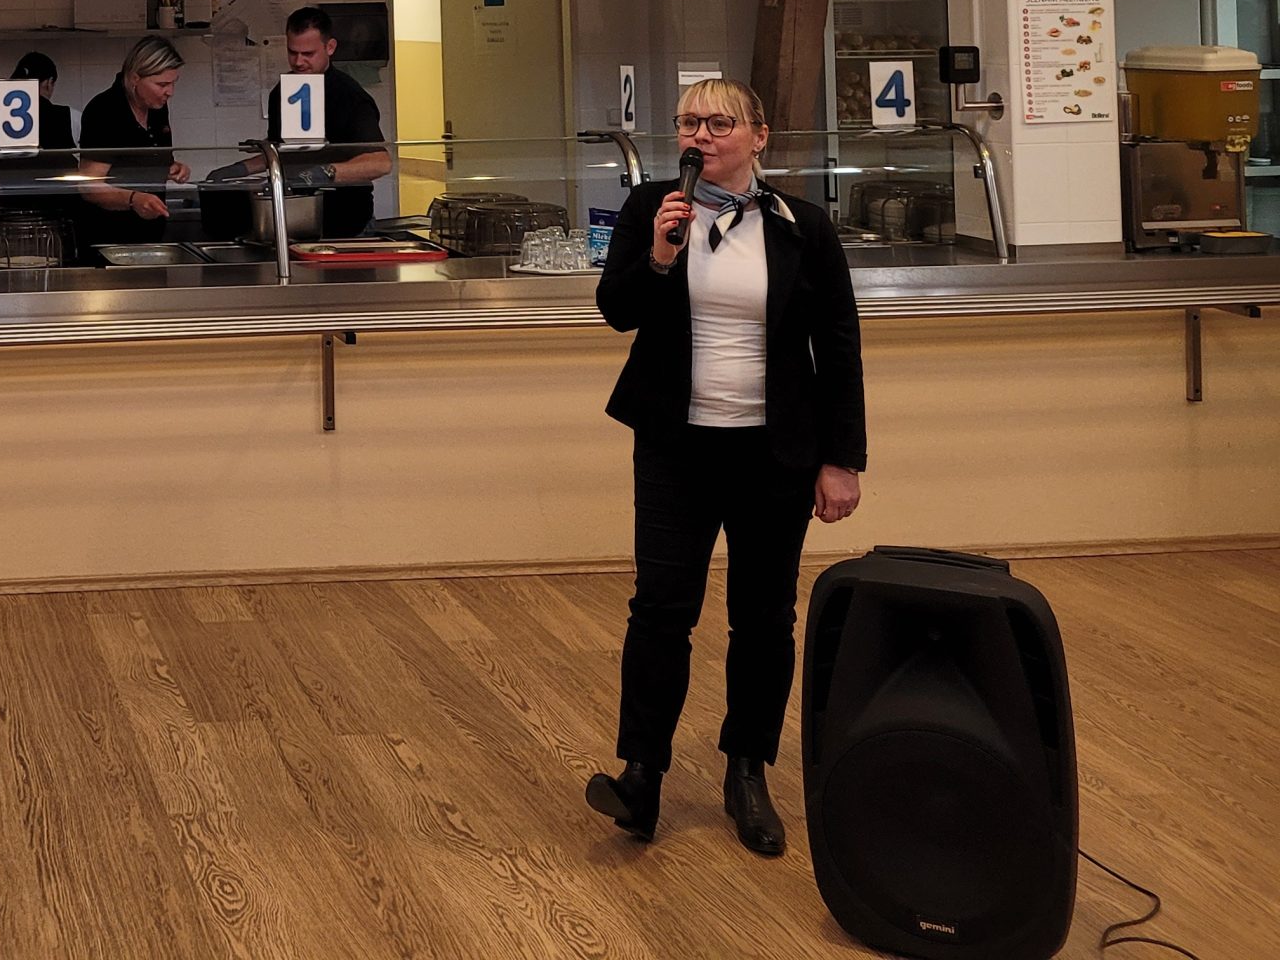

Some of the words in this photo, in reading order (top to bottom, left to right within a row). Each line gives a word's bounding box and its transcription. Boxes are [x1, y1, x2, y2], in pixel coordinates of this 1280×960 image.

[2, 90, 33, 139] 3
[287, 83, 311, 131] 1
[623, 74, 633, 122] 2
[875, 69, 911, 118] 4
[919, 921, 955, 934] gemini
